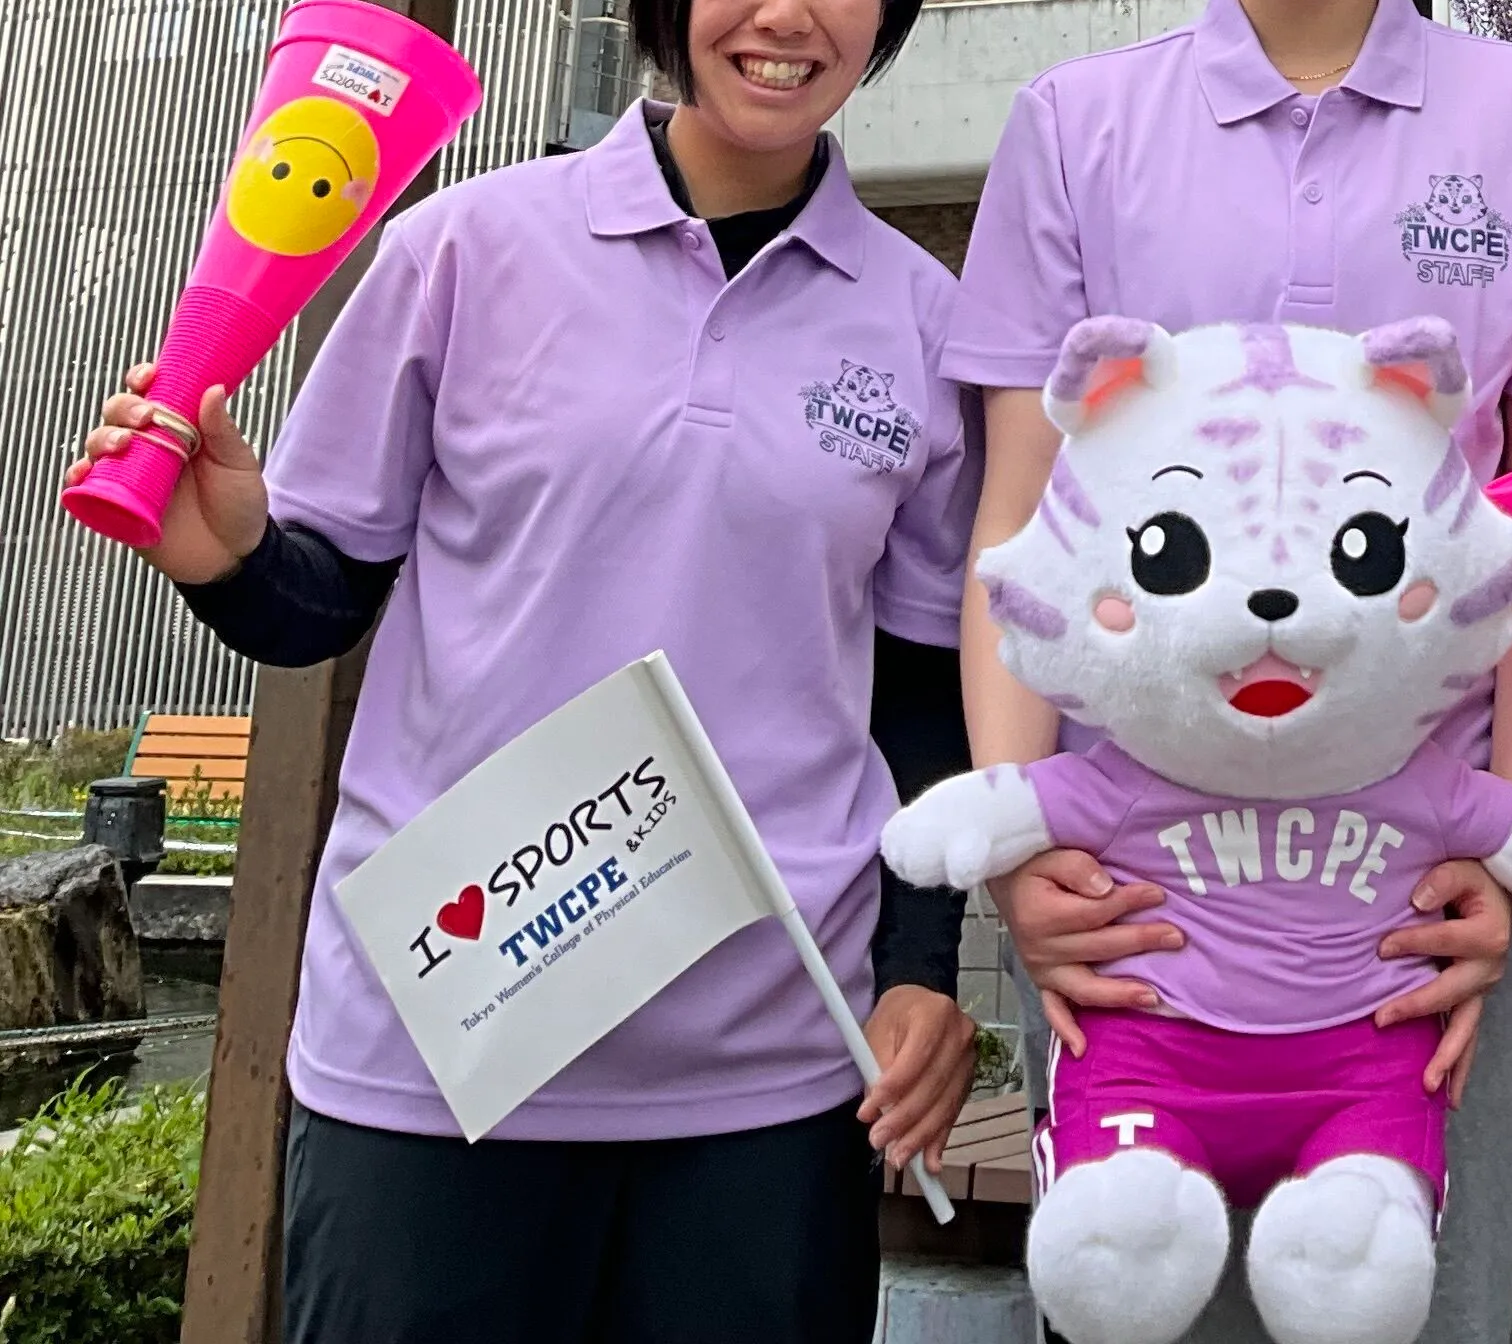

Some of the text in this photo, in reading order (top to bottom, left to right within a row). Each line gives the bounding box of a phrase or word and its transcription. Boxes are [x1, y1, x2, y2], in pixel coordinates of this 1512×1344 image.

[320, 69, 368, 95] SPORTS
[1407, 223, 1504, 257] TWCPE
[1417, 259, 1494, 289] STAFF
[811, 398, 910, 456] TWCPE
[819, 430, 896, 476] STAFF
[410, 756, 666, 979] I SPORTS
[1157, 807, 1404, 905] TWCPE
[498, 856, 628, 967] TWCPE
[460, 849, 692, 1032] Tokyo Women's College of Physical Education
[1100, 1113, 1154, 1145] T
